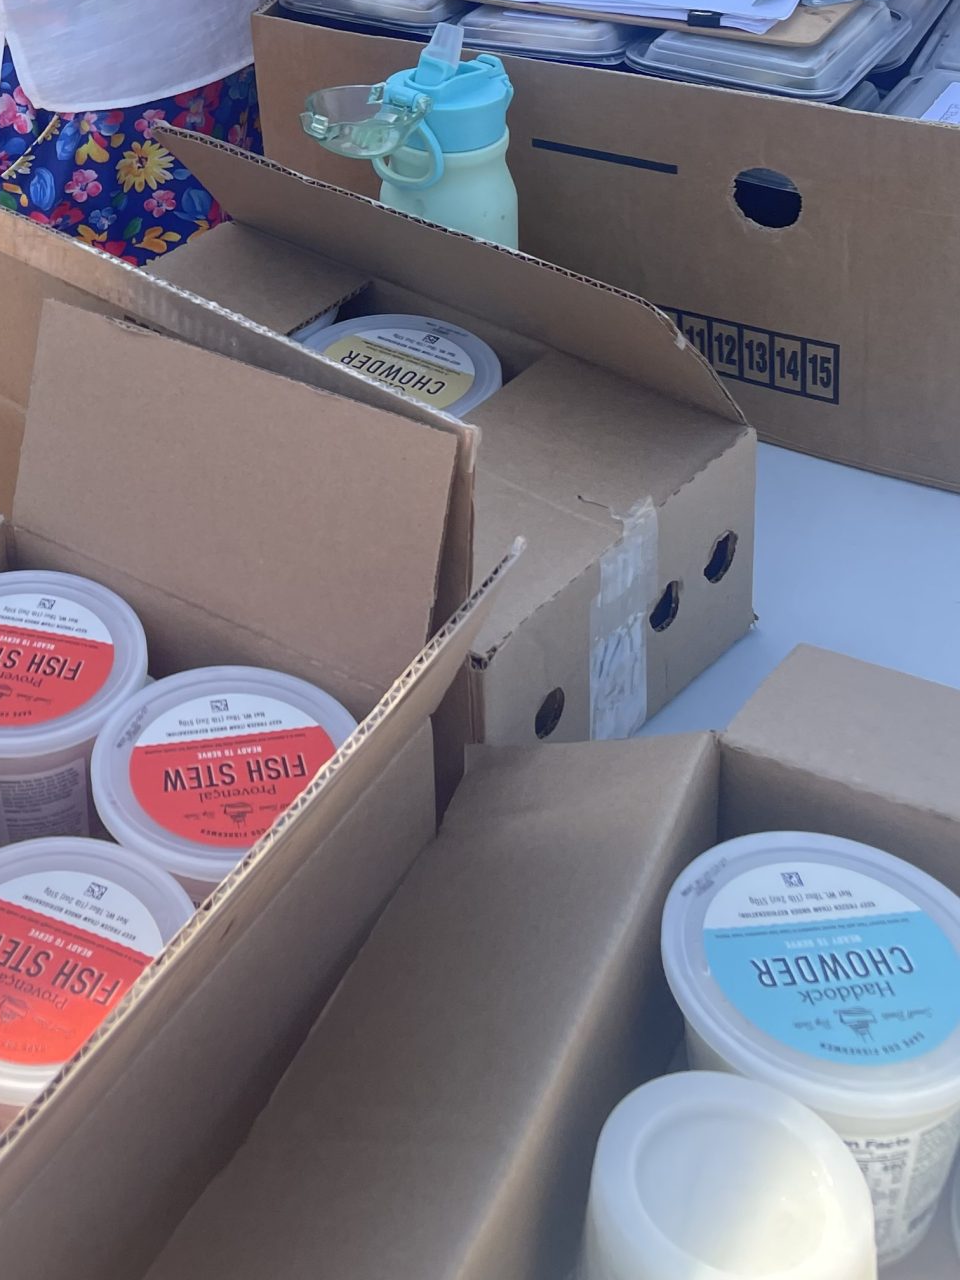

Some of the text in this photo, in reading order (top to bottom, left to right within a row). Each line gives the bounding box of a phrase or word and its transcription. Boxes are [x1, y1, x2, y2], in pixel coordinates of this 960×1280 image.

[341, 350, 445, 395] CHOWDER
[714, 332, 737, 365] 12
[746, 339, 767, 373] 13
[776, 347, 799, 381] 14
[808, 354, 831, 389] 15
[0, 635, 20, 643] SERVE
[32, 641, 55, 650] READY
[26, 652, 83, 681] FISH
[198, 745, 262, 760] READY TO SERVE
[163, 753, 307, 791] FISH STEW
[199, 783, 277, 802] Provençal
[28, 929, 93, 958] READY TO SERVE
[750, 946, 914, 988] CHOWDER
[52, 960, 122, 1006] FISH
[799, 980, 896, 1005] Haddock
